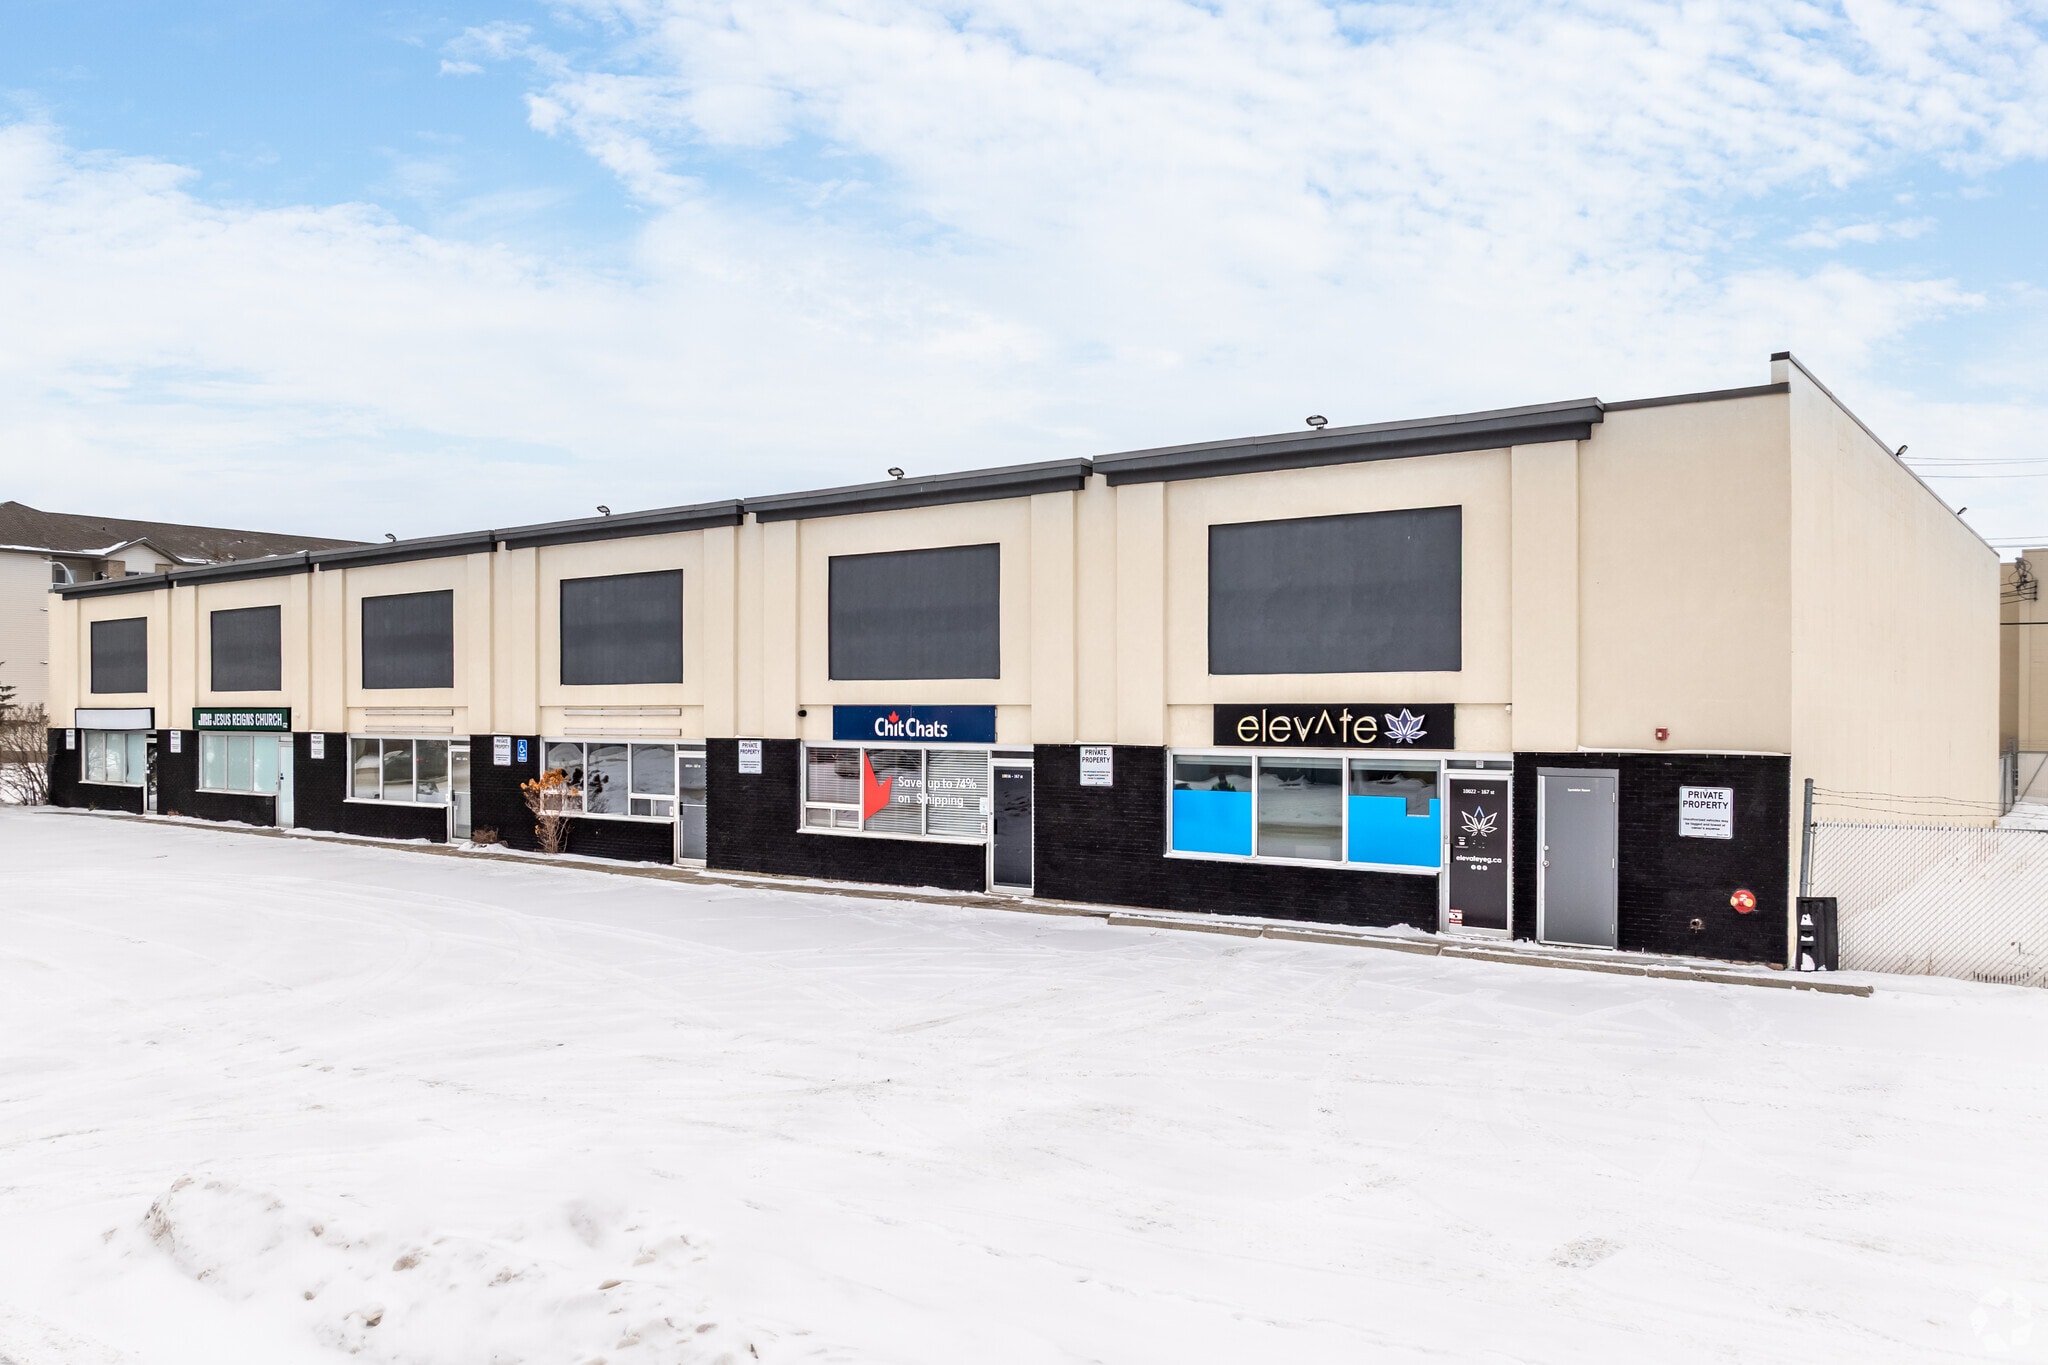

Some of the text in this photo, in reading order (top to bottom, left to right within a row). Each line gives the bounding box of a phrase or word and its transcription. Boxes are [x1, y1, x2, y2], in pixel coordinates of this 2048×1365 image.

[212, 713, 231, 726] JESUS
[232, 713, 254, 726] REIGNS
[255, 713, 282, 726] CHURCH
[874, 716, 948, 738] Chit Chats
[898, 776, 977, 791] Save up to 74%
[898, 794, 910, 803] on
[1688, 791, 1723, 799] PRIVATE
[1683, 800, 1728, 809] PROPERTY
